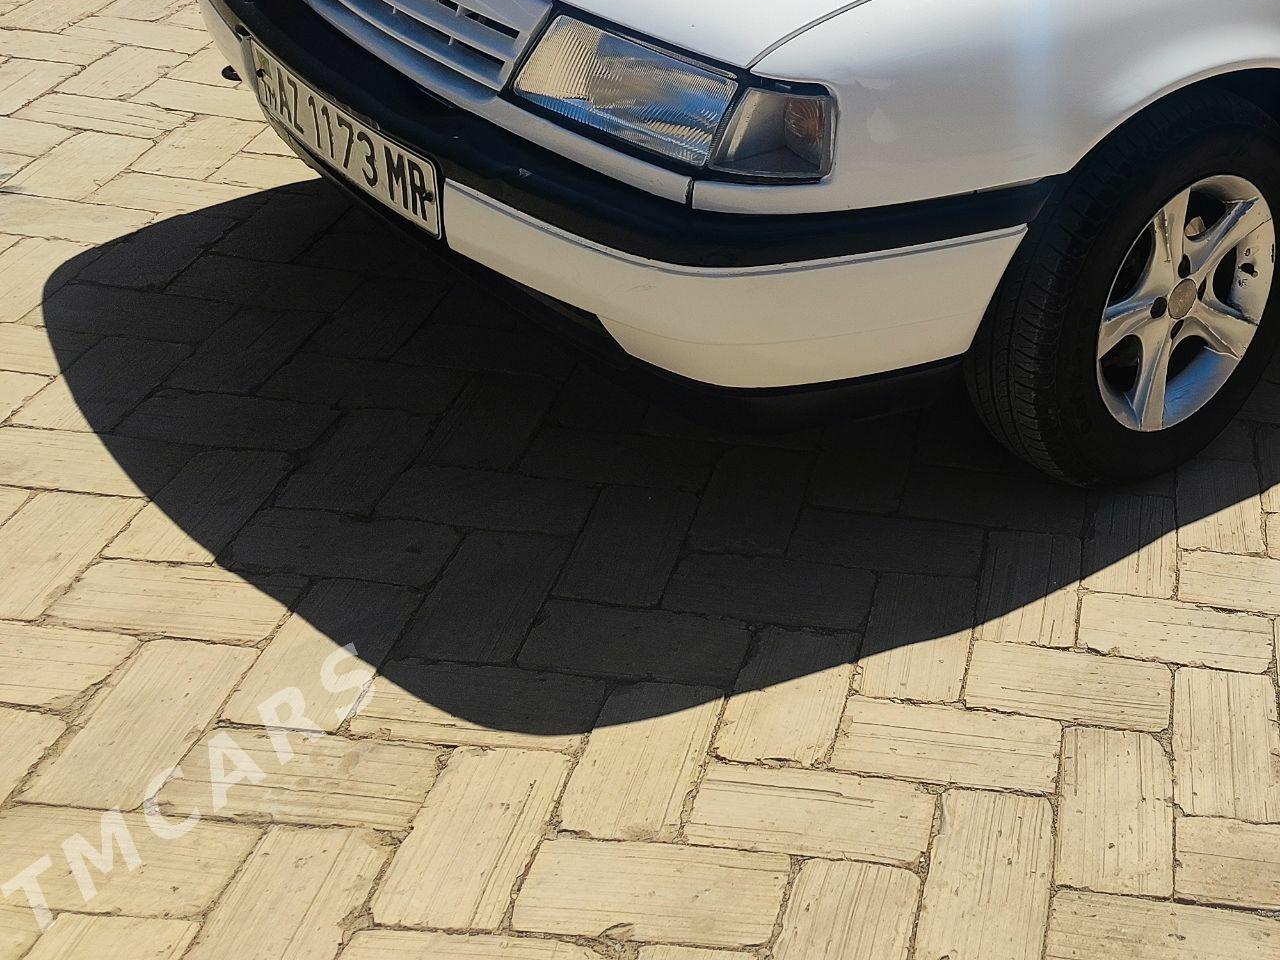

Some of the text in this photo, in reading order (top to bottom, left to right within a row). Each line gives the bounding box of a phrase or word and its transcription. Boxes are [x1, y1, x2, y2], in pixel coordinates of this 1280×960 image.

[277, 67, 429, 222] AZ 1173 MR
